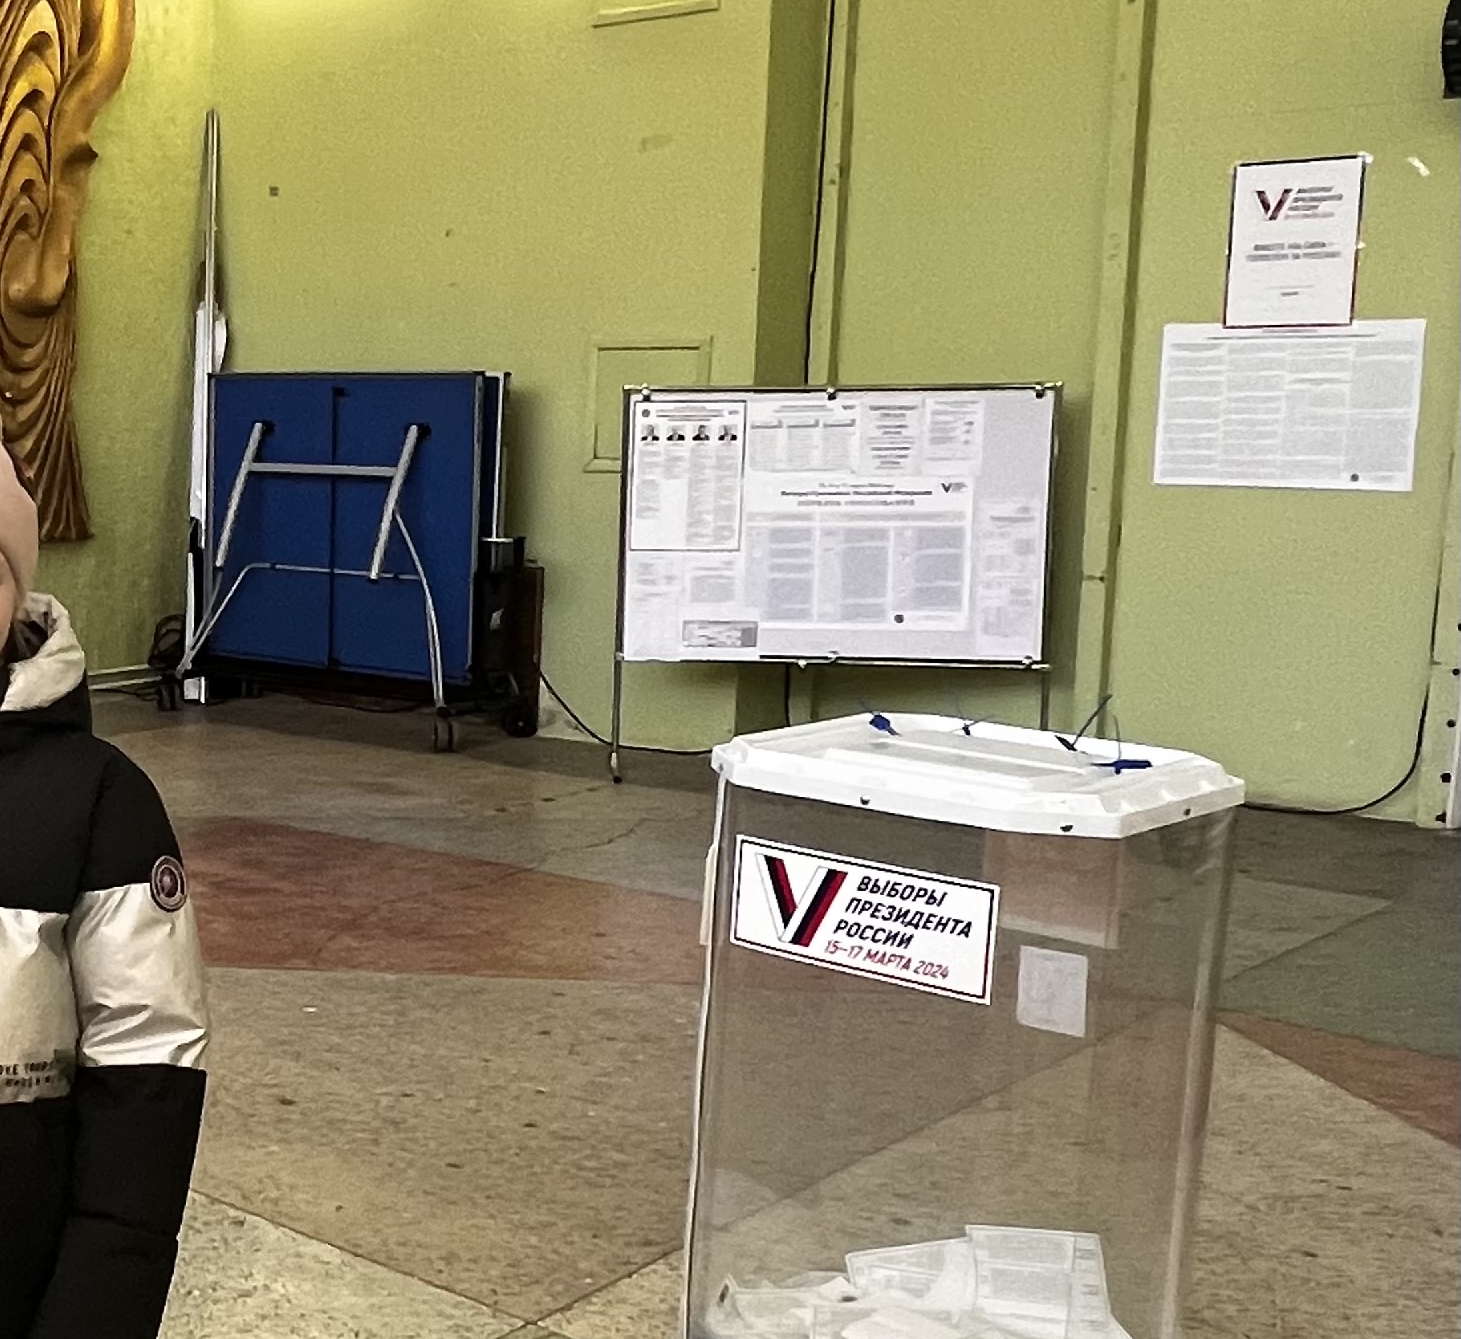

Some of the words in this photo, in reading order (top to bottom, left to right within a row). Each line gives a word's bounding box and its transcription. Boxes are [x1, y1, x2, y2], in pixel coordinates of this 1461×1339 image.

[857, 876, 947, 906] ВЫБОРЫ
[844, 897, 973, 939] ПРЕЗИДЕНТА
[832, 919, 915, 950] РОССИИ
[864, 952, 910, 971] МАРТА
[913, 959, 950, 980] 2024
